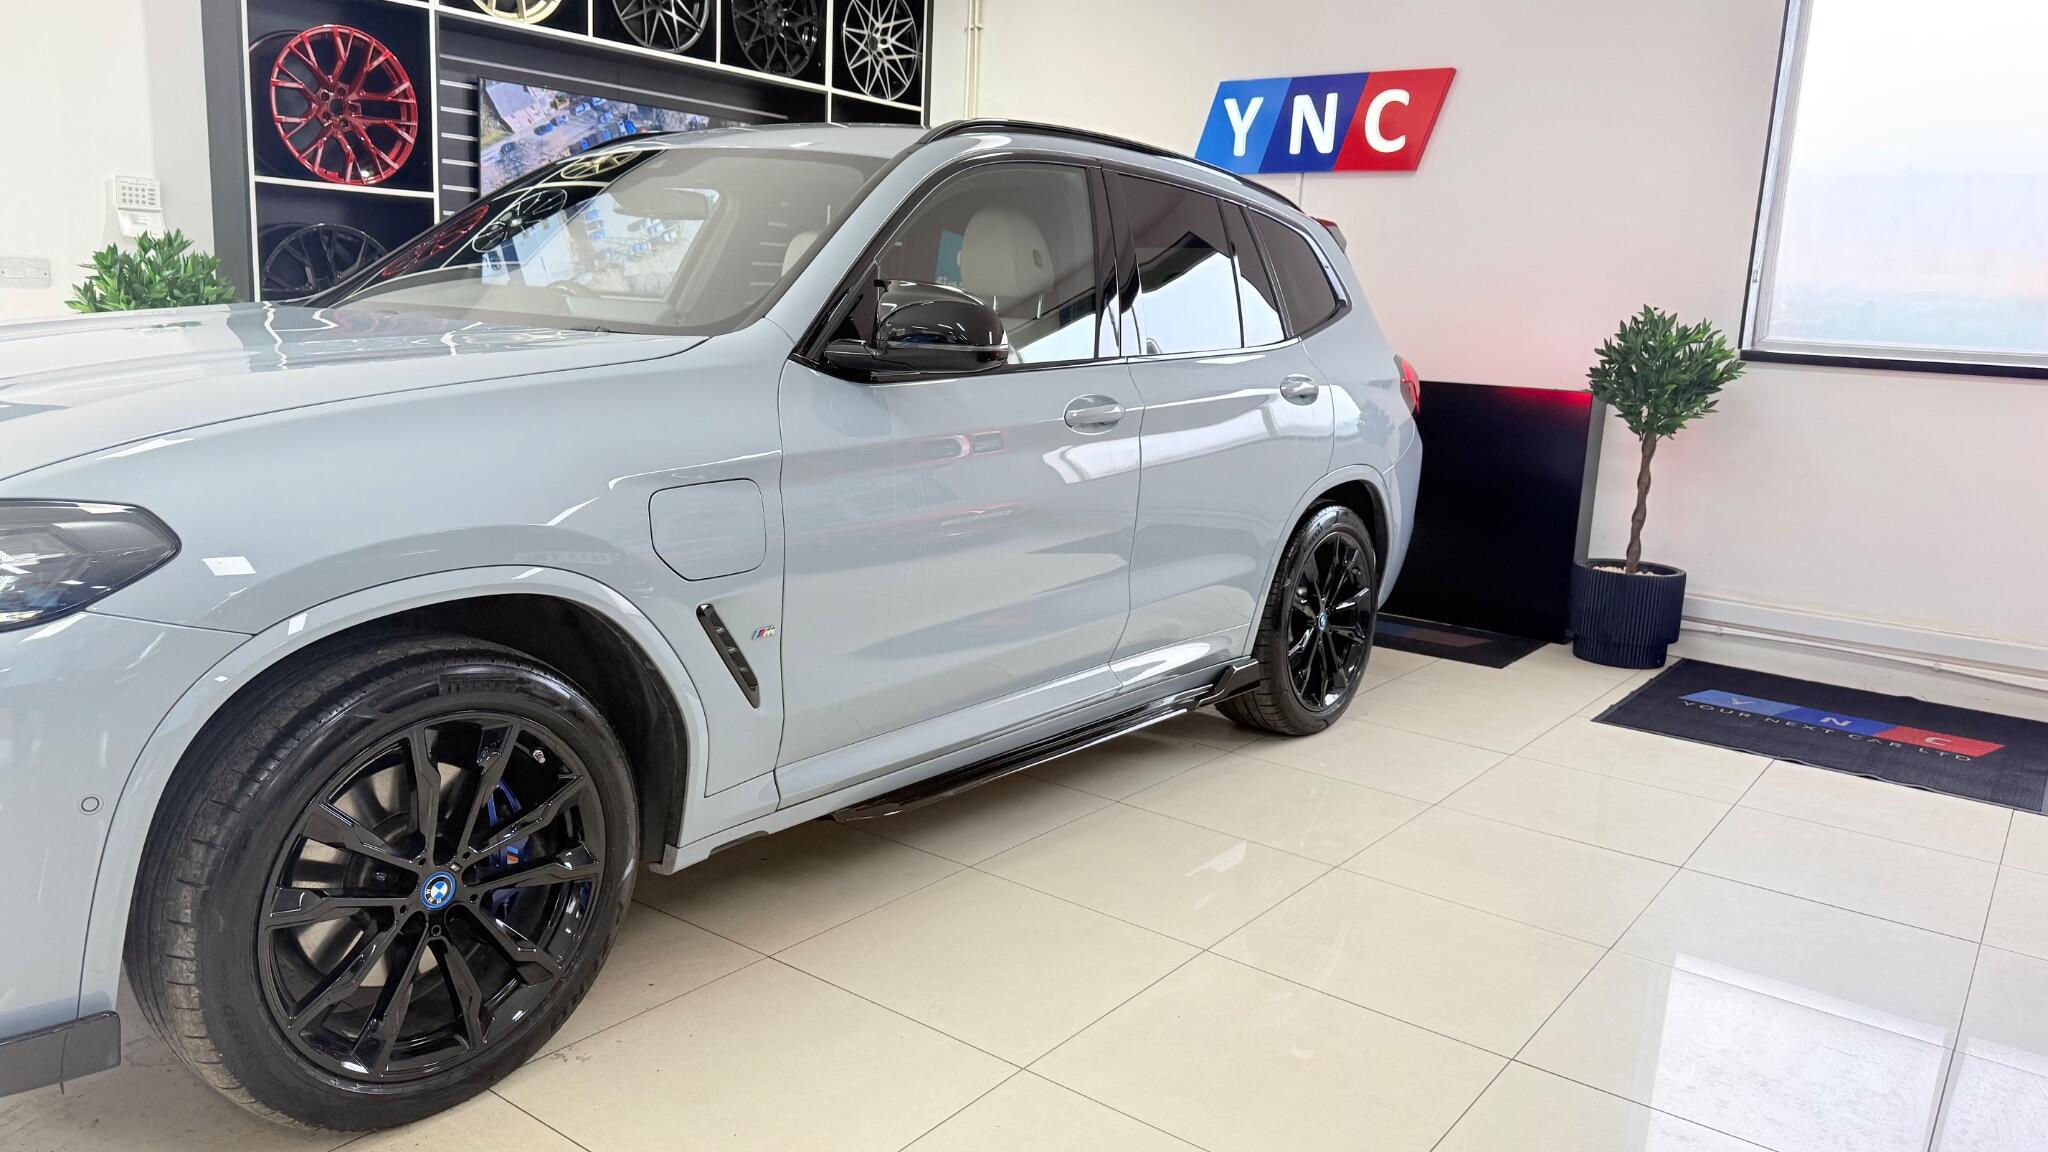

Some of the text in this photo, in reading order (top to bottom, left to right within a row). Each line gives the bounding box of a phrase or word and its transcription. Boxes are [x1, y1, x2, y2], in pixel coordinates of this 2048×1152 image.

[1224, 88, 1410, 157] YNC
[1682, 700, 1971, 762] YOUR NEXT CAR LTD
